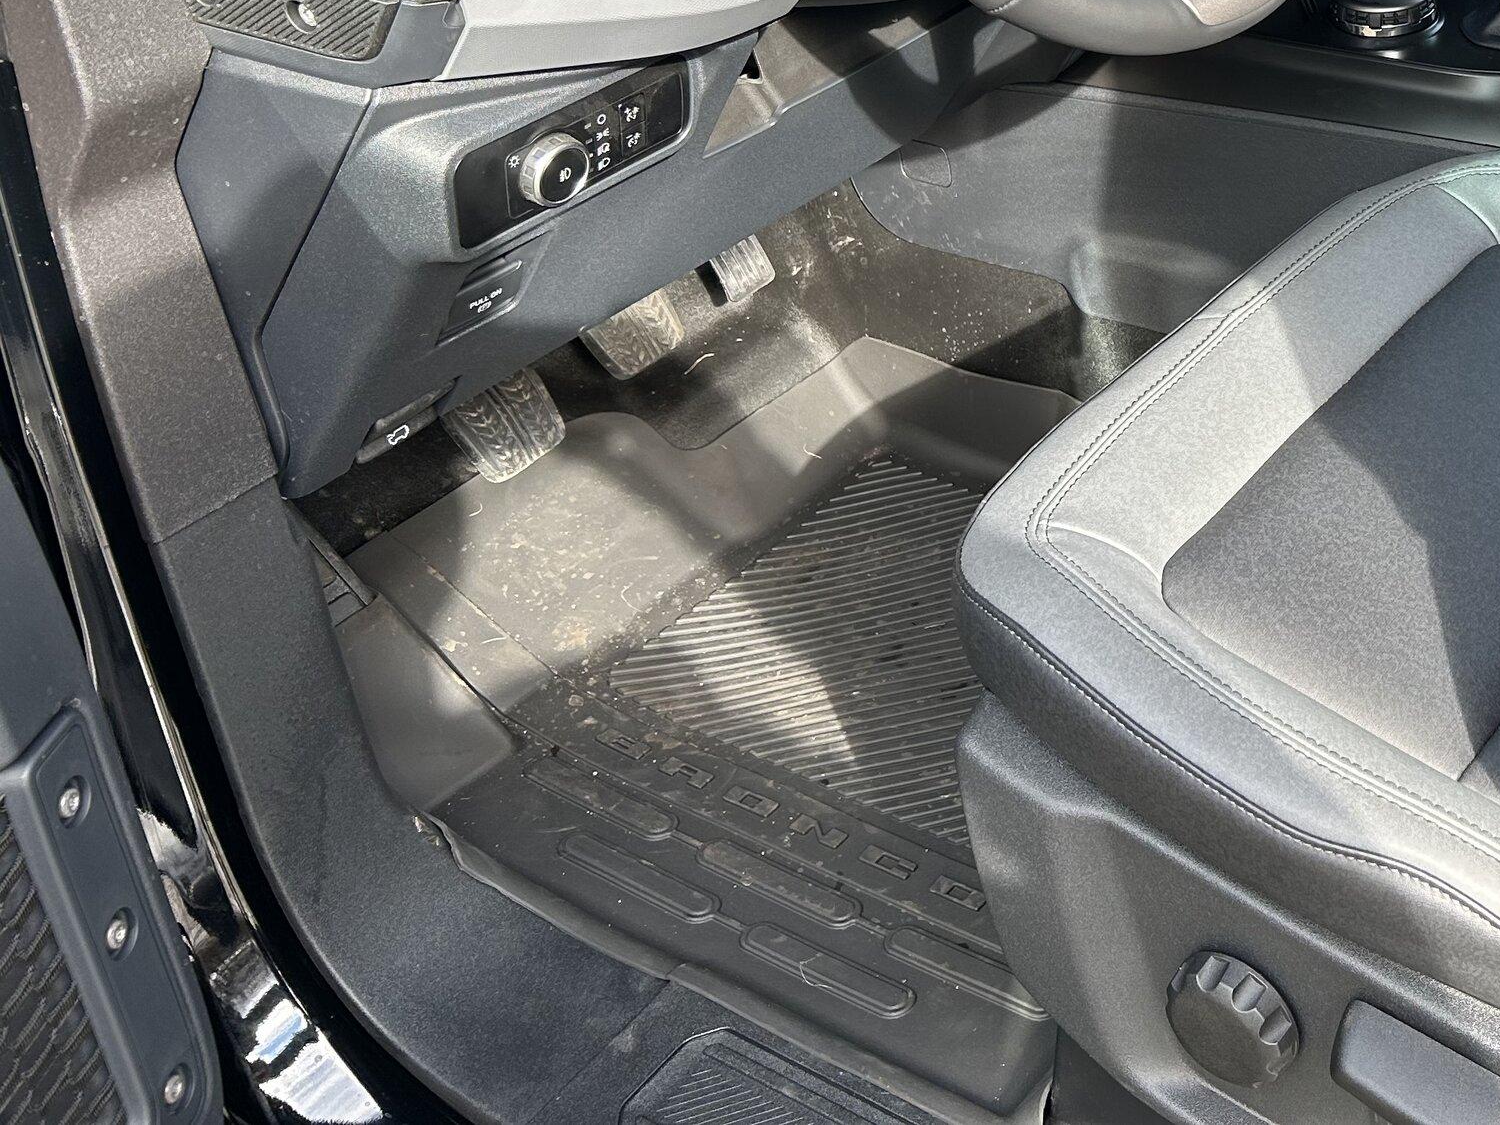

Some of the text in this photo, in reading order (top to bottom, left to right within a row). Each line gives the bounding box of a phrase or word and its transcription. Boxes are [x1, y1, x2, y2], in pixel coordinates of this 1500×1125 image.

[469, 288, 502, 309] PULL ON
[595, 727, 988, 912] BRONCO
